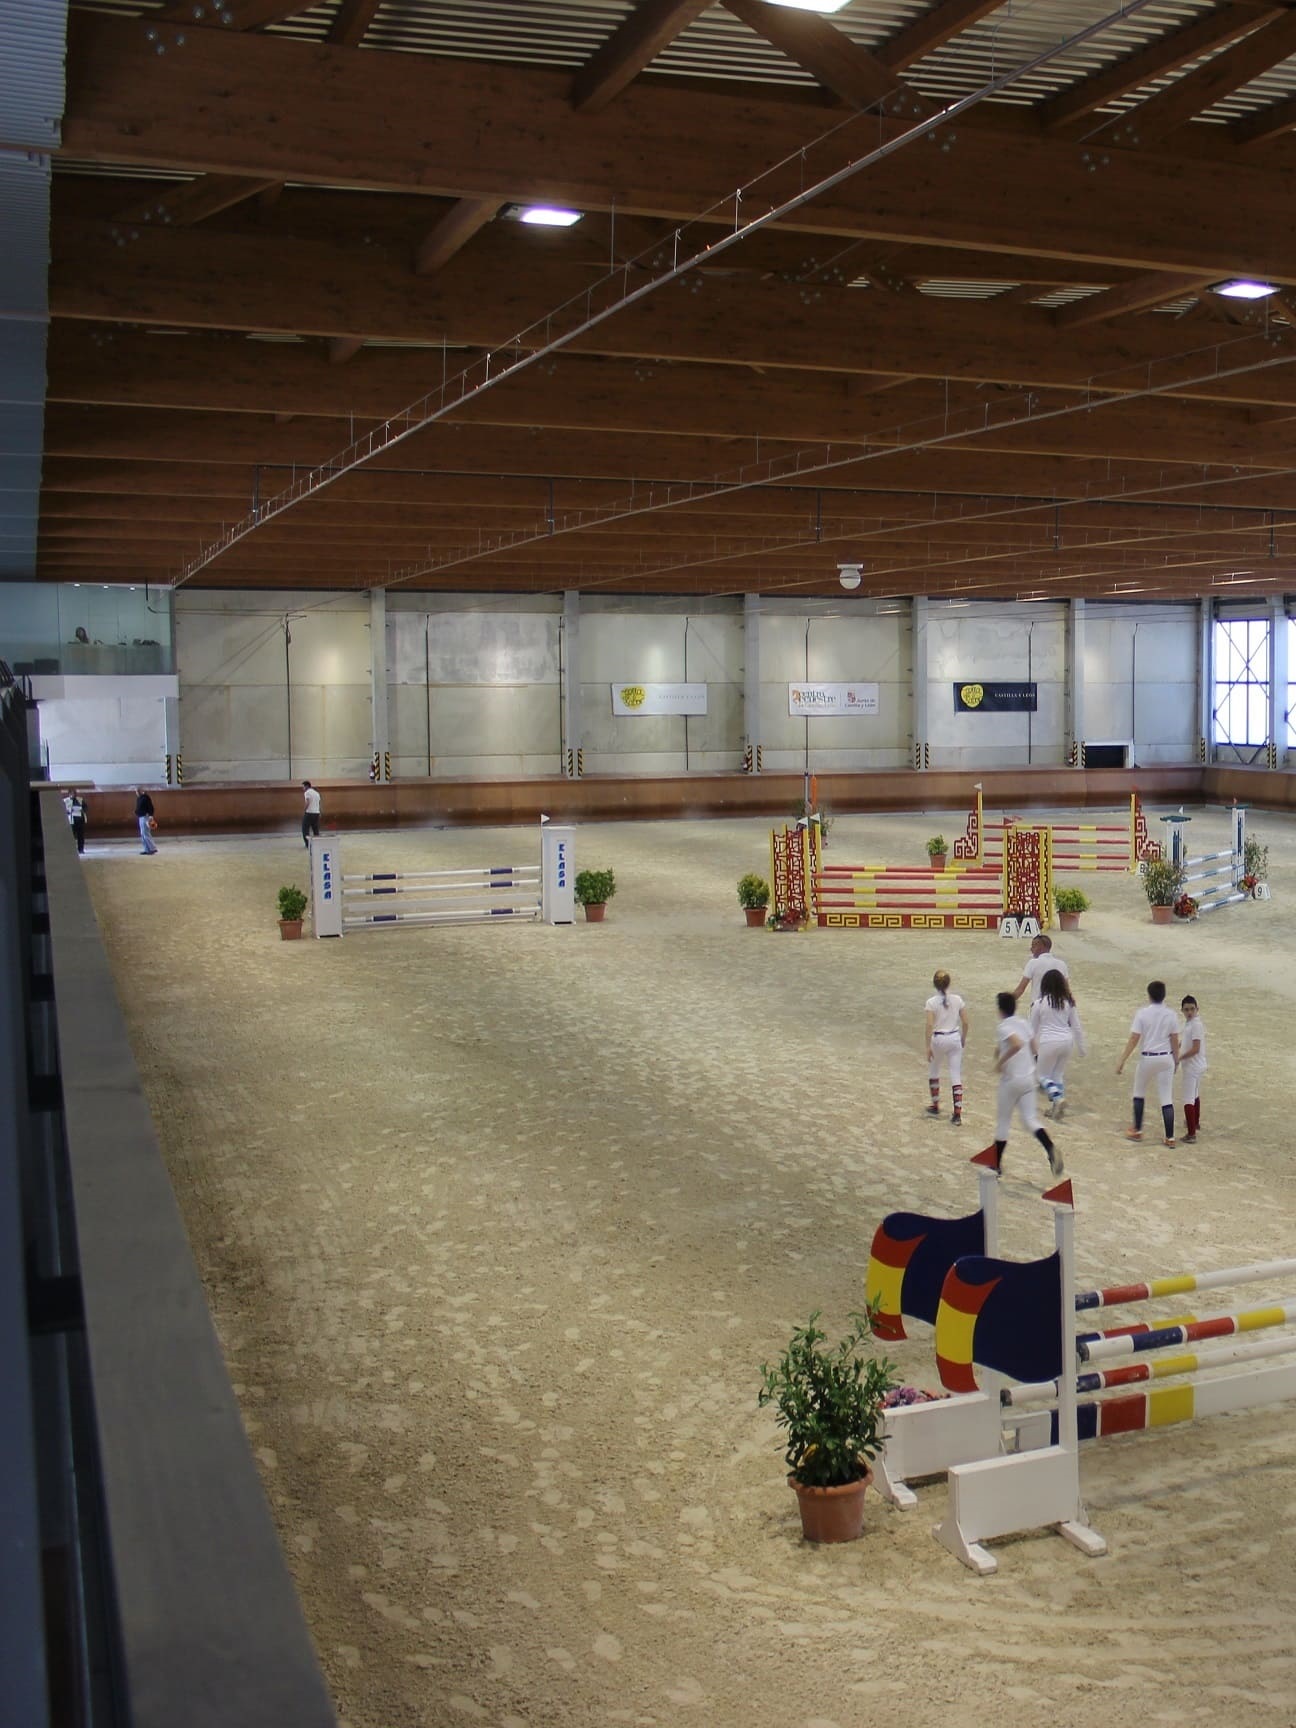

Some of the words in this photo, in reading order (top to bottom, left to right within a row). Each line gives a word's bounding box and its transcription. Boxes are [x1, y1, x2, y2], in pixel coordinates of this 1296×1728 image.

[558, 843, 566, 888] ELASA
[322, 852, 332, 900] ELASA
[1257, 886, 1263, 897] 9
[1005, 922, 1011, 934] 5
[1024, 921, 1032, 935] A
